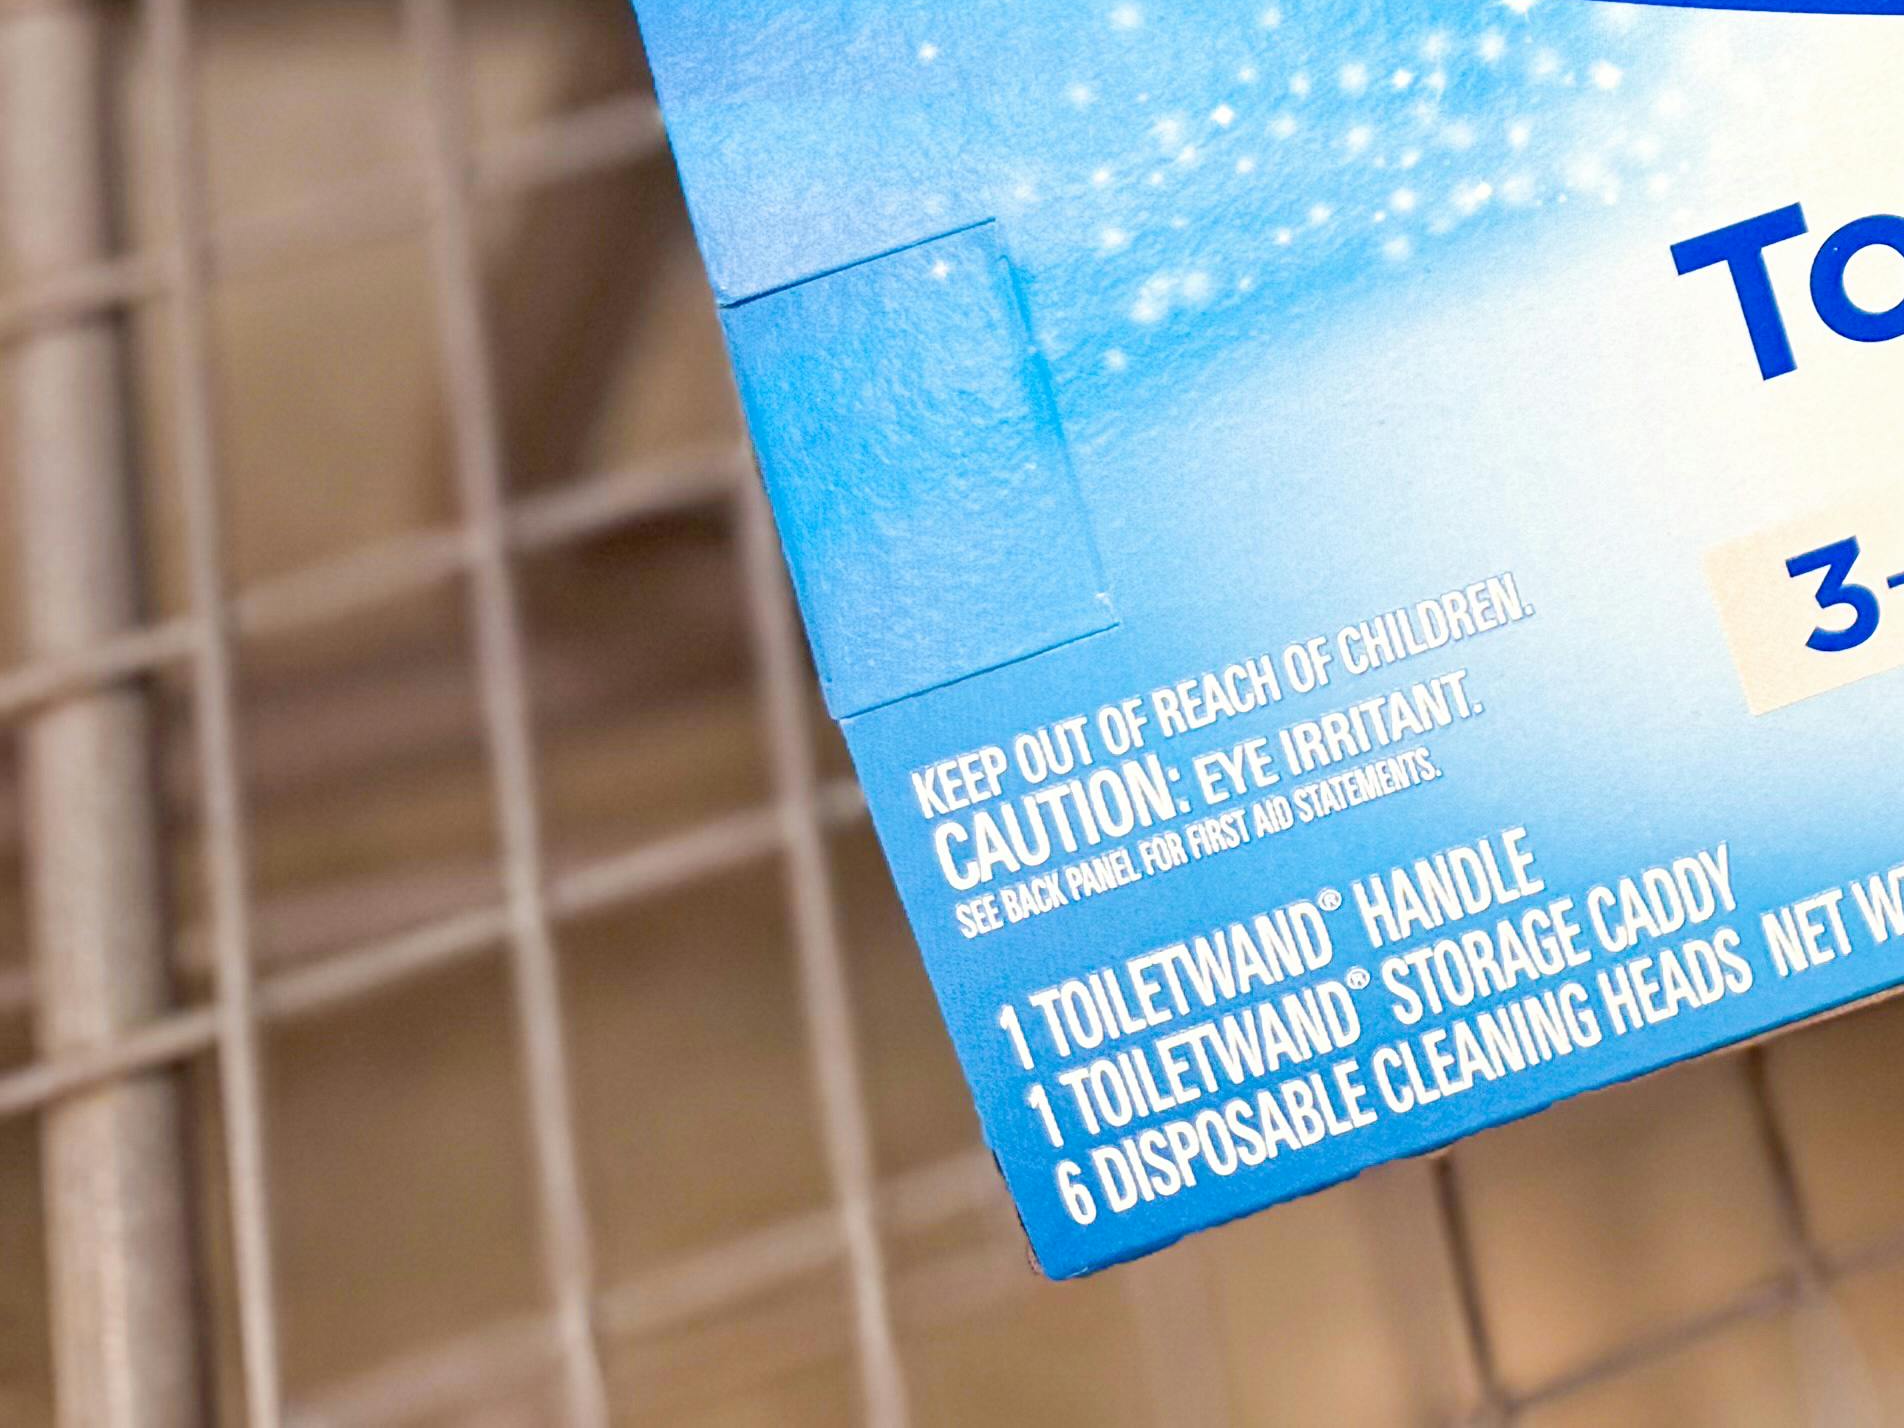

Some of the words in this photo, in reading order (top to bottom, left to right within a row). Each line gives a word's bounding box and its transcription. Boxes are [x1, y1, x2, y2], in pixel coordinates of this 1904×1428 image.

[911, 745, 1008, 819] KEEP
[1013, 715, 1093, 784] OUT
[1096, 697, 1148, 756] OF
[1151, 654, 1282, 737] REACH
[1282, 636, 1331, 693] OF
[1337, 568, 1538, 674] CHILDREN.
[933, 752, 1191, 891] CAUTION:
[1192, 737, 1280, 805] EYE
[1281, 666, 1483, 775] IRRITANT.
[955, 892, 1004, 939] SEE
[999, 870, 1068, 924] BACK
[1063, 846, 1142, 900] PANEL
[1137, 829, 1189, 875] FOR
[1184, 807, 1250, 859] FIRST
[1251, 794, 1294, 838] AID
[1292, 744, 1441, 823] STATEMENTS.
[996, 1003, 1035, 1070] 1
[1352, 826, 1545, 948] HANDLE
[1761, 887, 1852, 977] NET
[1025, 1082, 1065, 1148] 1
[1380, 896, 1592, 1025] STORAGE
[1586, 838, 1736, 953] CADDY
[1055, 1159, 1098, 1226] 6
[1090, 1058, 1378, 1213] DISPOSABLE
[1372, 981, 1603, 1114] CLEANING
[1597, 926, 1753, 1035] HEADS
